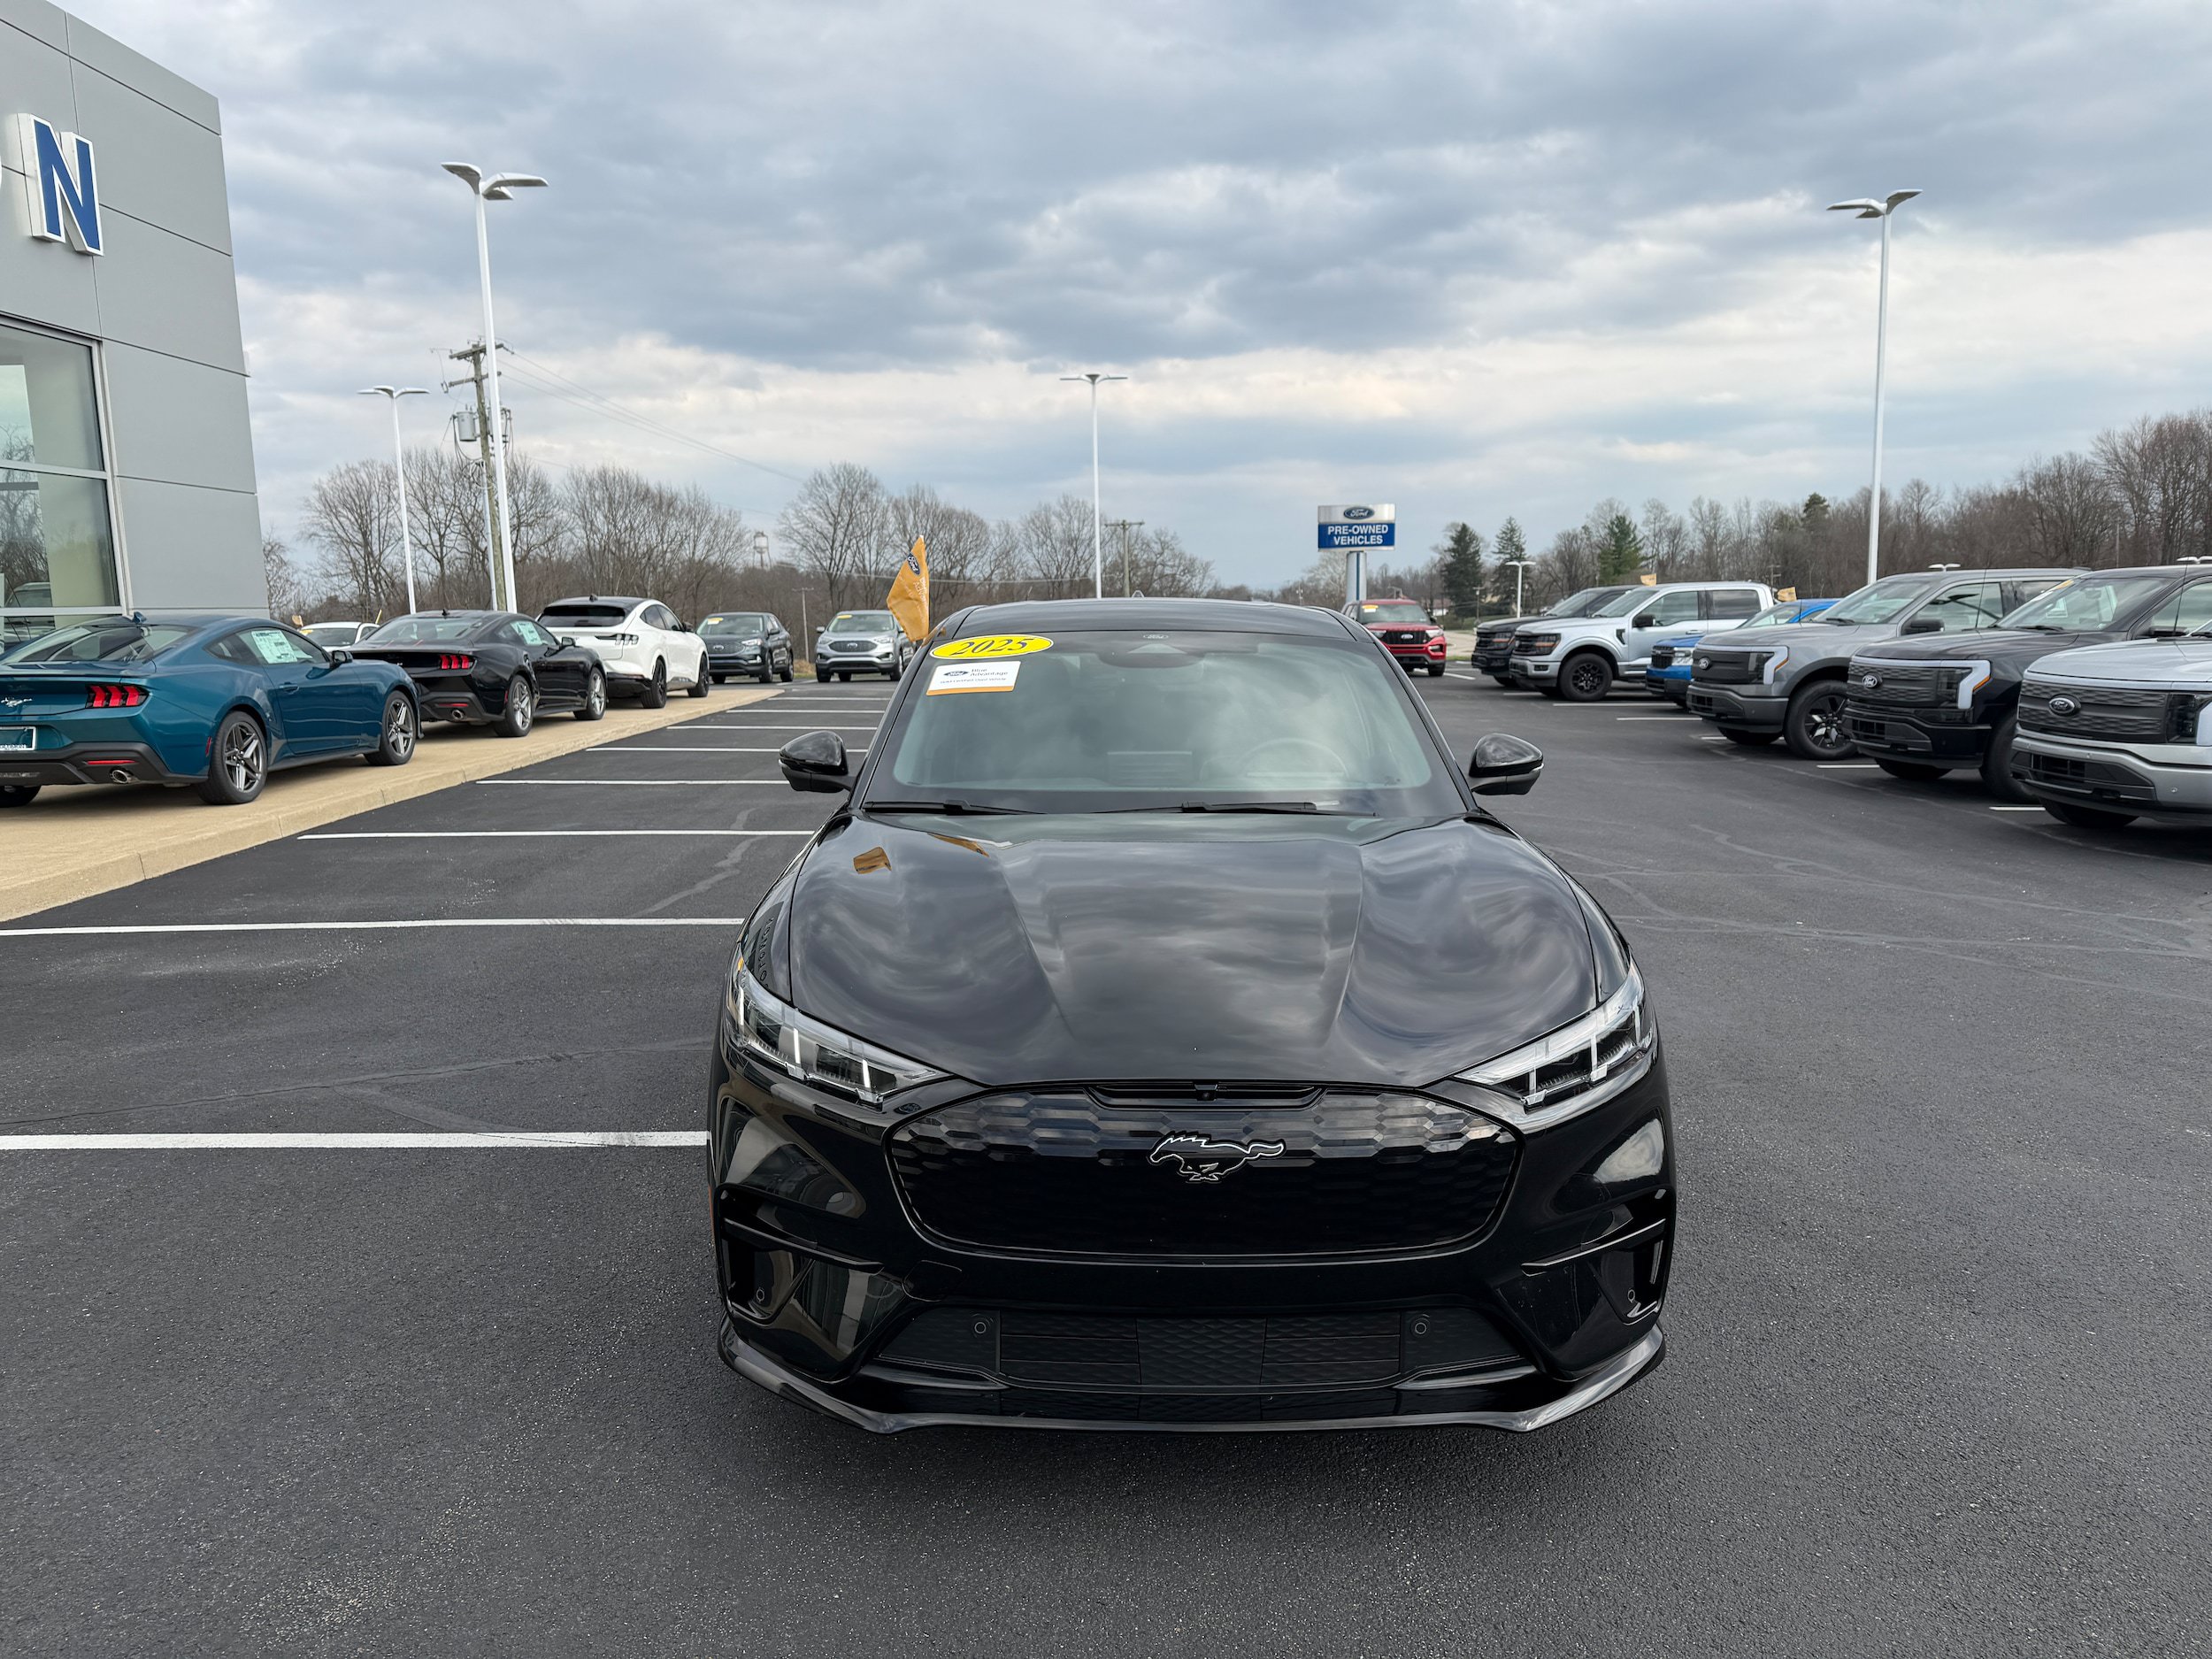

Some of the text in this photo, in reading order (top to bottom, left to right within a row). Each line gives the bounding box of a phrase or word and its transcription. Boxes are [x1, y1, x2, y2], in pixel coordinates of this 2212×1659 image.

[1327, 525, 1389, 535] PRE-OWNED
[1333, 535, 1383, 545] VEHICLES
[949, 639, 1033, 656] 2025
